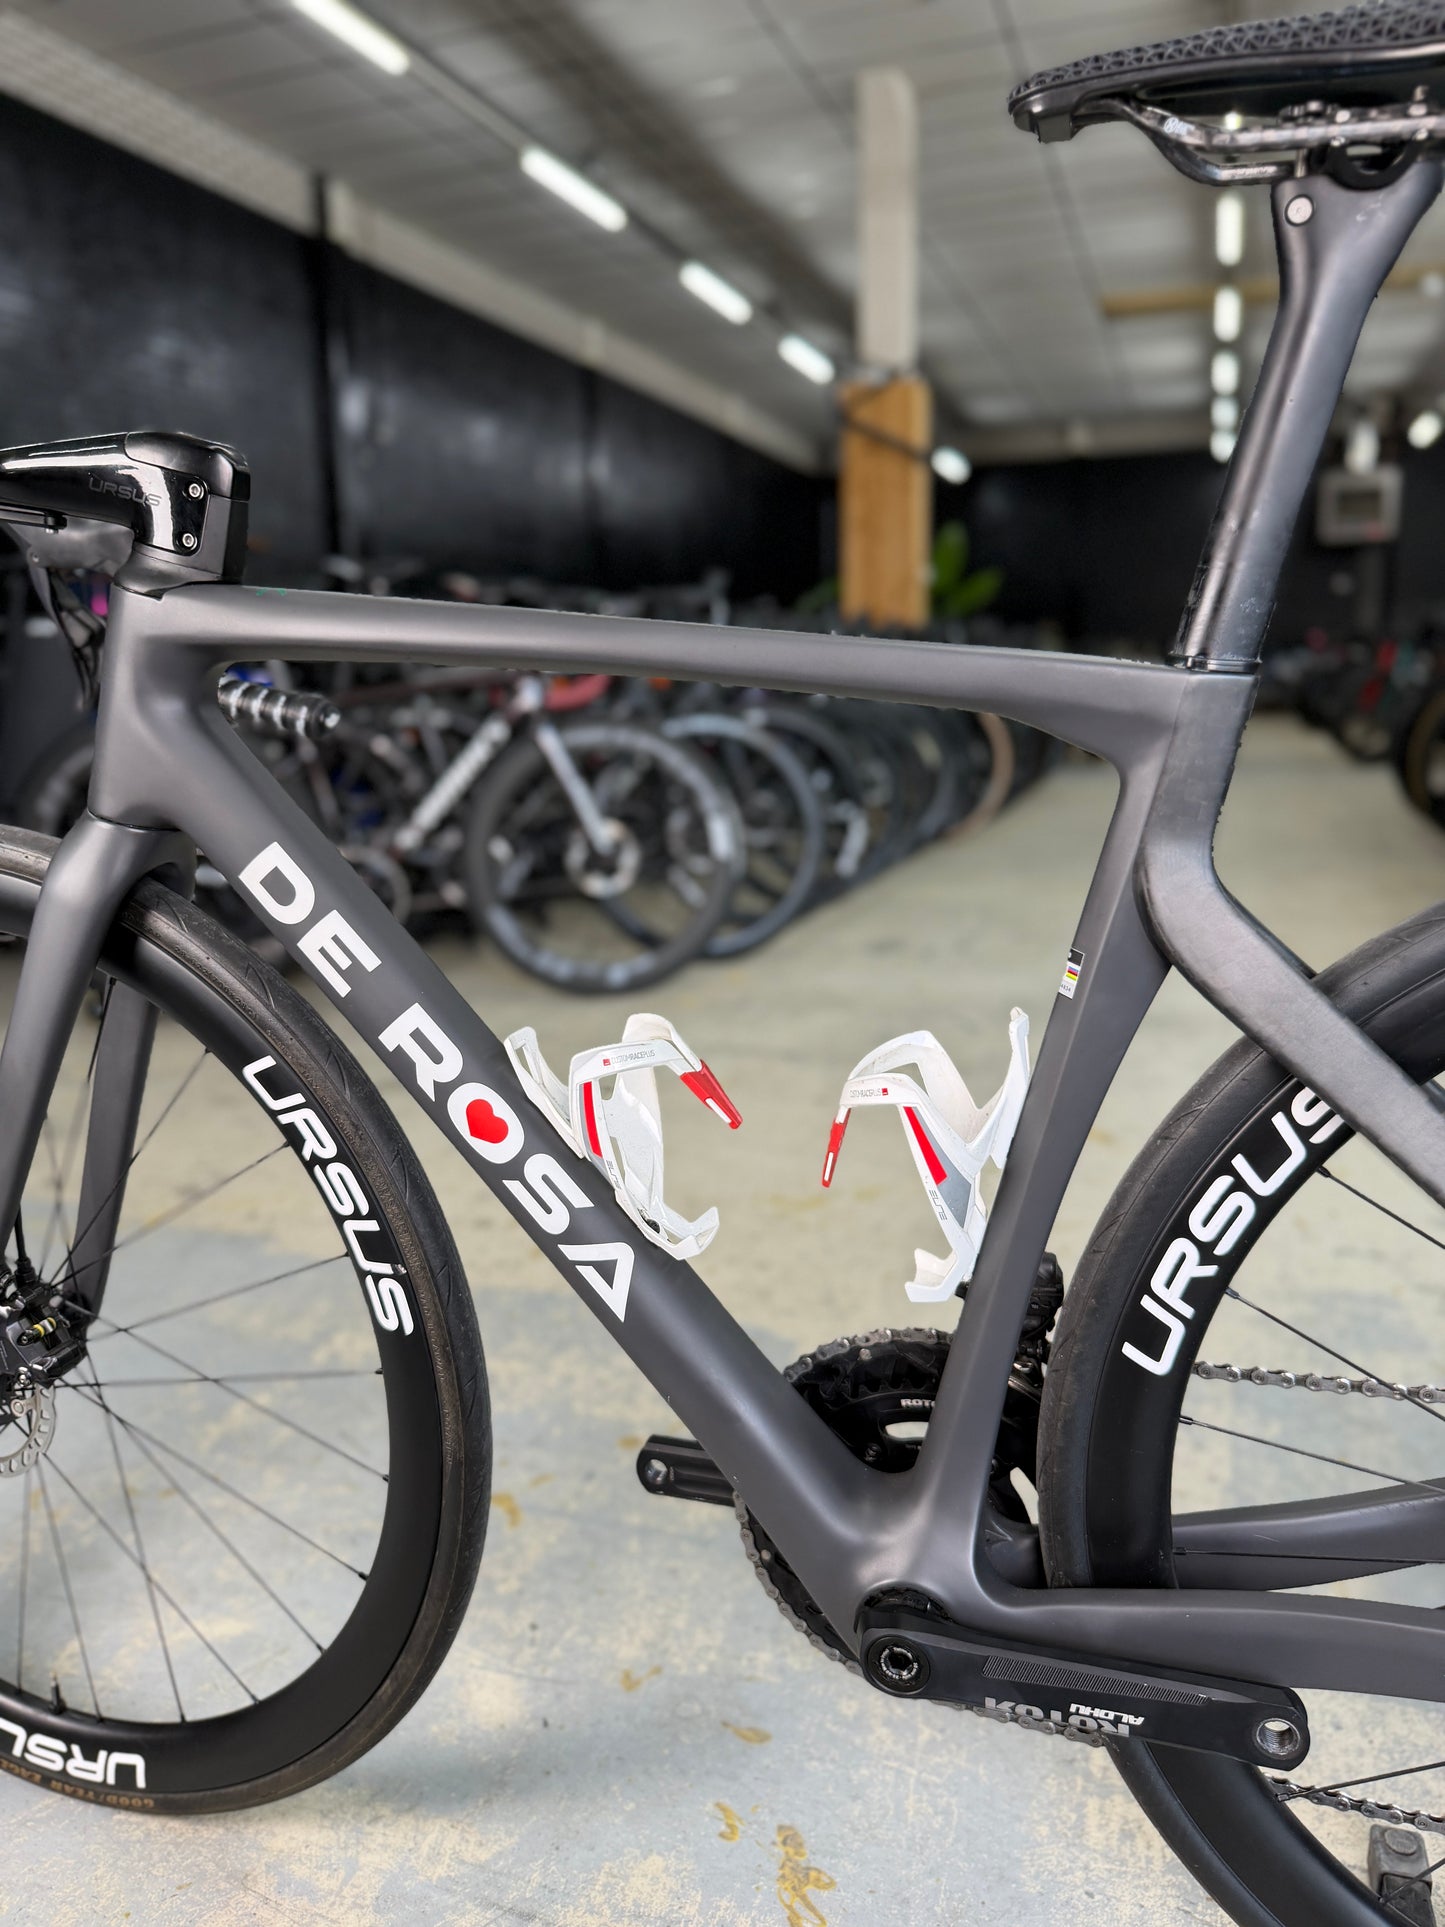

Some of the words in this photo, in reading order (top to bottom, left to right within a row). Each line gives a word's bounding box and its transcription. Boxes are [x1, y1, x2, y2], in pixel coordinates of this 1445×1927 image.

[89, 477, 162, 506] URSUS
[239, 842, 382, 998] DE
[378, 1003, 635, 1323] ROSA
[242, 1056, 414, 1336] URSUS
[1122, 1087, 1345, 1376] URSUS
